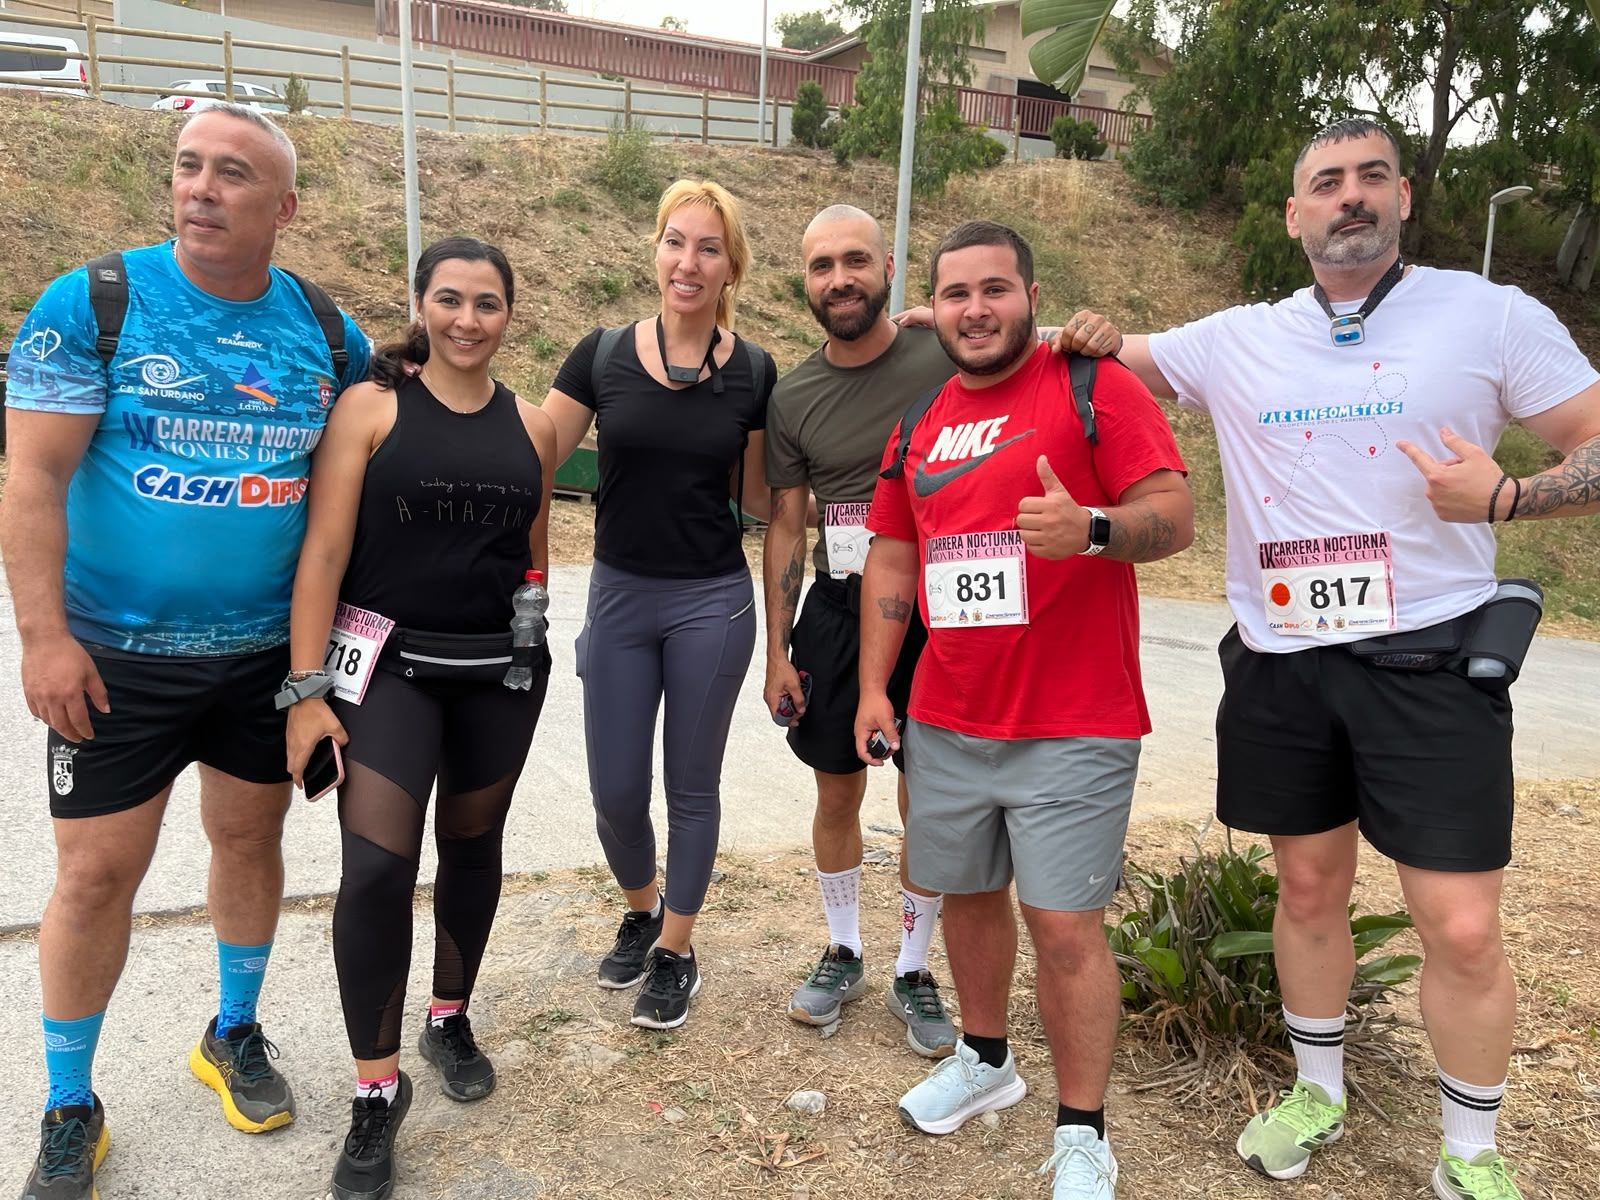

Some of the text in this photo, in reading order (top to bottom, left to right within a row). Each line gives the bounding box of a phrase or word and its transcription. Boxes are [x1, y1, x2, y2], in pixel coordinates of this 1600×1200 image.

[138, 387, 158, 397] SAN
[160, 389, 205, 401] URBANO
[157, 416, 254, 445] CARRERA
[927, 415, 1010, 463] NIKE
[159, 440, 250, 462] MONTES
[258, 447, 284, 463] DE
[135, 465, 238, 505] CASH
[420, 477, 453, 493] today
[476, 482, 506, 495] going
[826, 503, 871, 526] IX CARRER
[840, 516, 868, 526] MONT
[932, 535, 964, 552] CARRERA
[966, 531, 1022, 549] NOCTURNA
[1260, 533, 1387, 569] IX CARRERA NOCTURNA
[933, 545, 1022, 562] MONTES DE CEUTA
[1274, 548, 1388, 568] MONTES DE CEUTA
[956, 571, 1005, 602] 831
[1309, 576, 1371, 609] 817
[324, 639, 362, 676] 718
